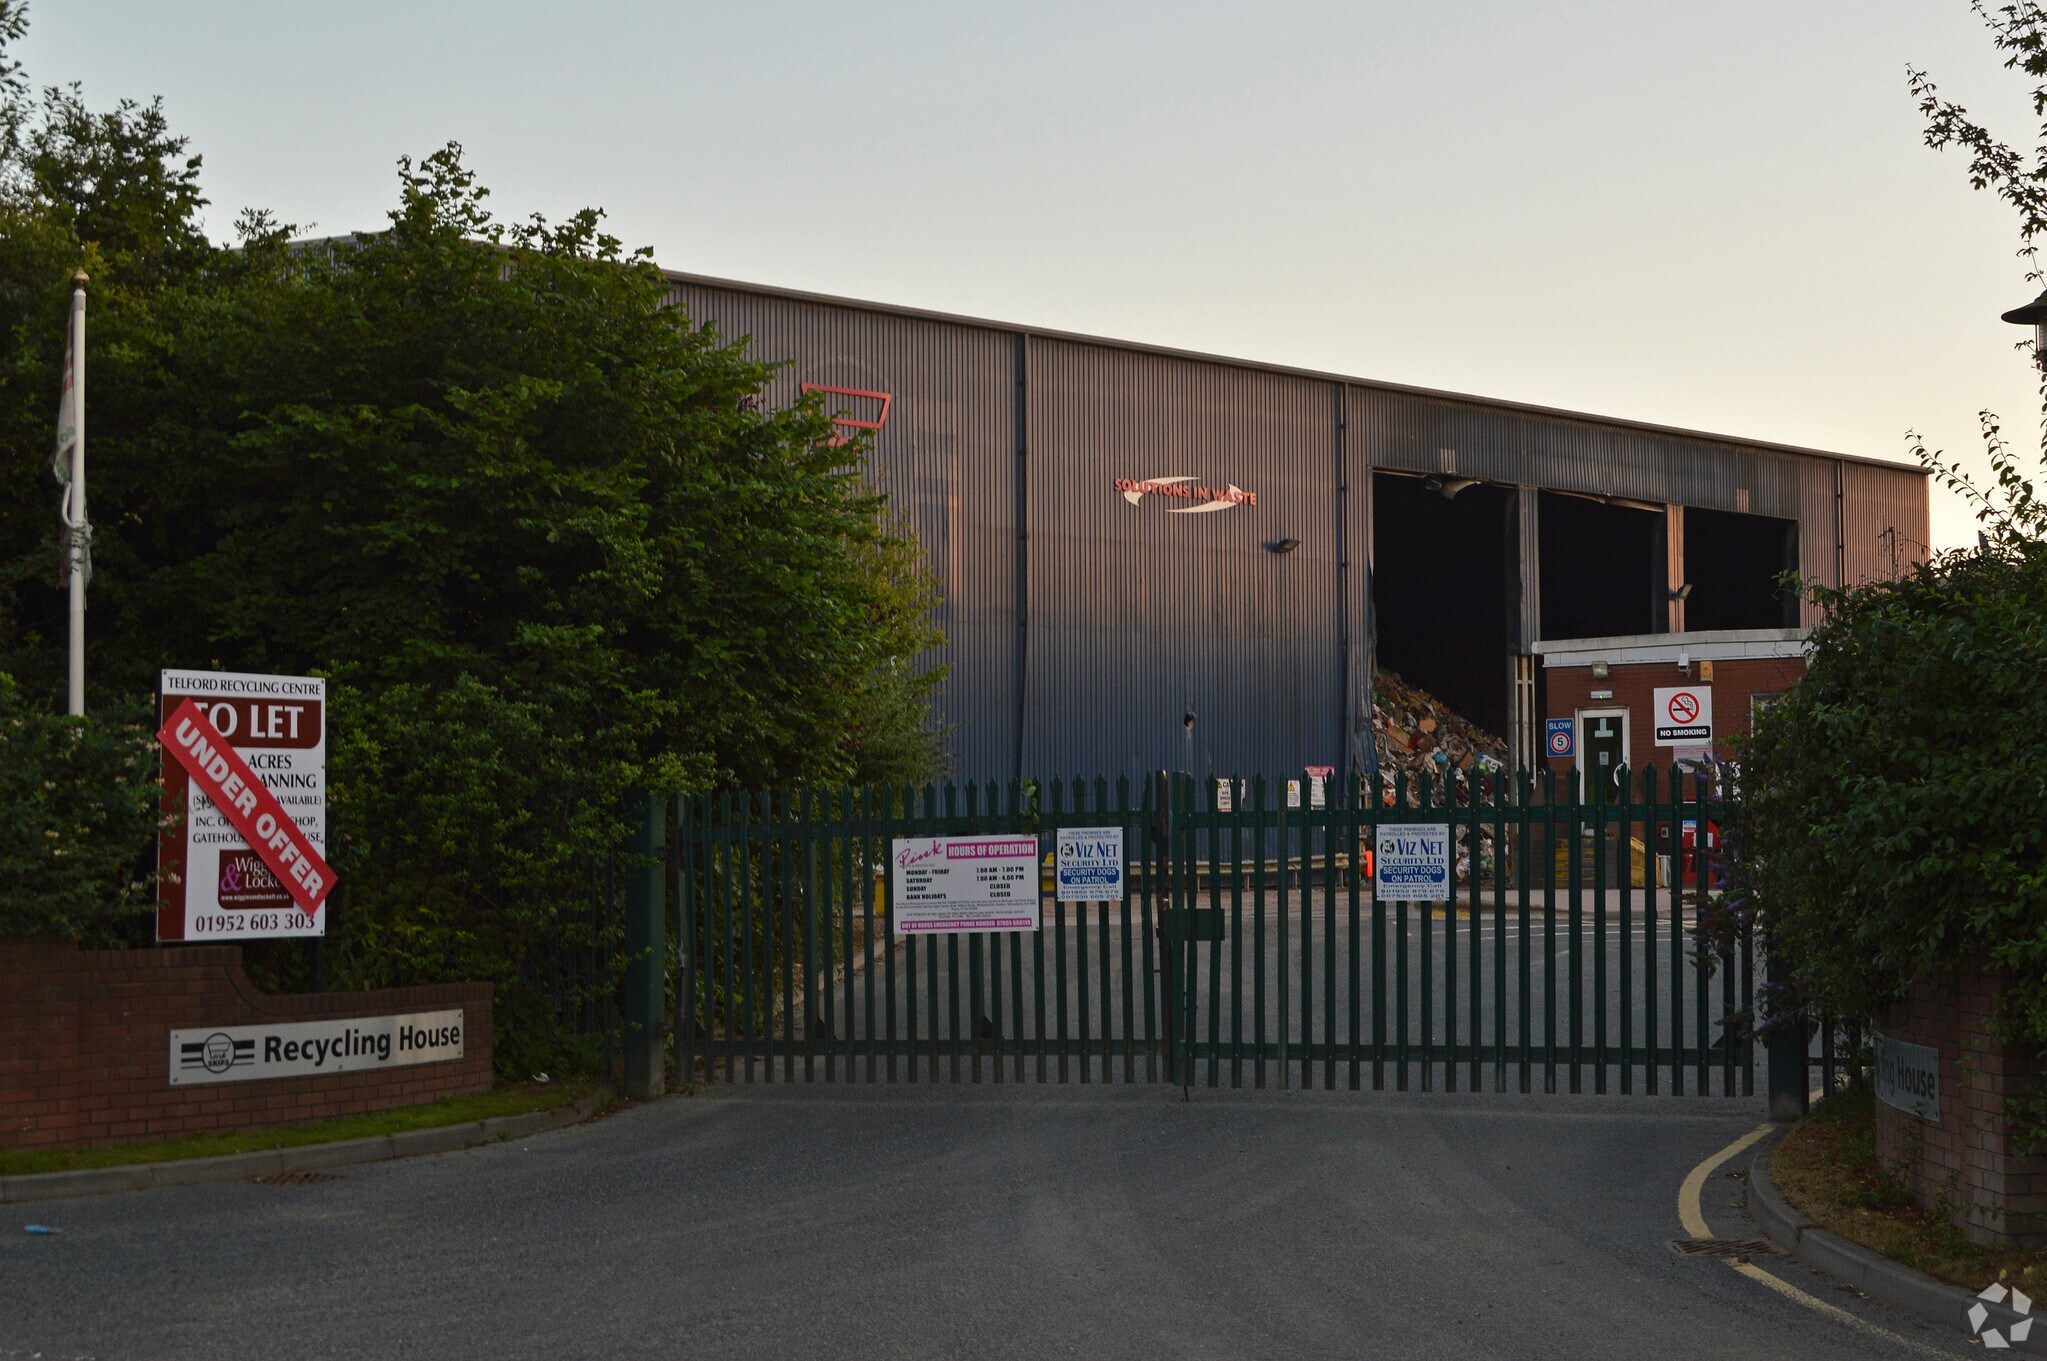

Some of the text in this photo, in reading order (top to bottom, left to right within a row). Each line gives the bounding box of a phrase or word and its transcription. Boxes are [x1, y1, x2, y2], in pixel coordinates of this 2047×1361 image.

[1114, 478, 1257, 506] SOLUTIONS IN WASTE
[168, 676, 320, 695] TELFORD RECYCLING CENTRE
[194, 702, 304, 739] O LET
[1548, 722, 1572, 730] SLOW
[1660, 728, 1707, 737] NO SMOKING
[1557, 737, 1564, 747] 5
[248, 754, 292, 769] ACRES
[260, 774, 317, 788] ANNING
[175, 717, 324, 899] UNDER OFFER
[195, 817, 216, 827] INC.
[895, 839, 943, 869] Pink
[948, 843, 1034, 857] HOURS OF OPERATION
[221, 863, 241, 891] &
[1063, 868, 1096, 876] SECURITY
[1383, 866, 1442, 874] SECURITY DOGS
[1070, 876, 1109, 884] ON PATROL
[1391, 875, 1433, 883] ON PATROL
[196, 913, 315, 932] 01952 603 303
[264, 1024, 460, 1067] Recycling House
[207, 1059, 230, 1067] SKIPS
[1897, 1055, 1935, 1100] House
